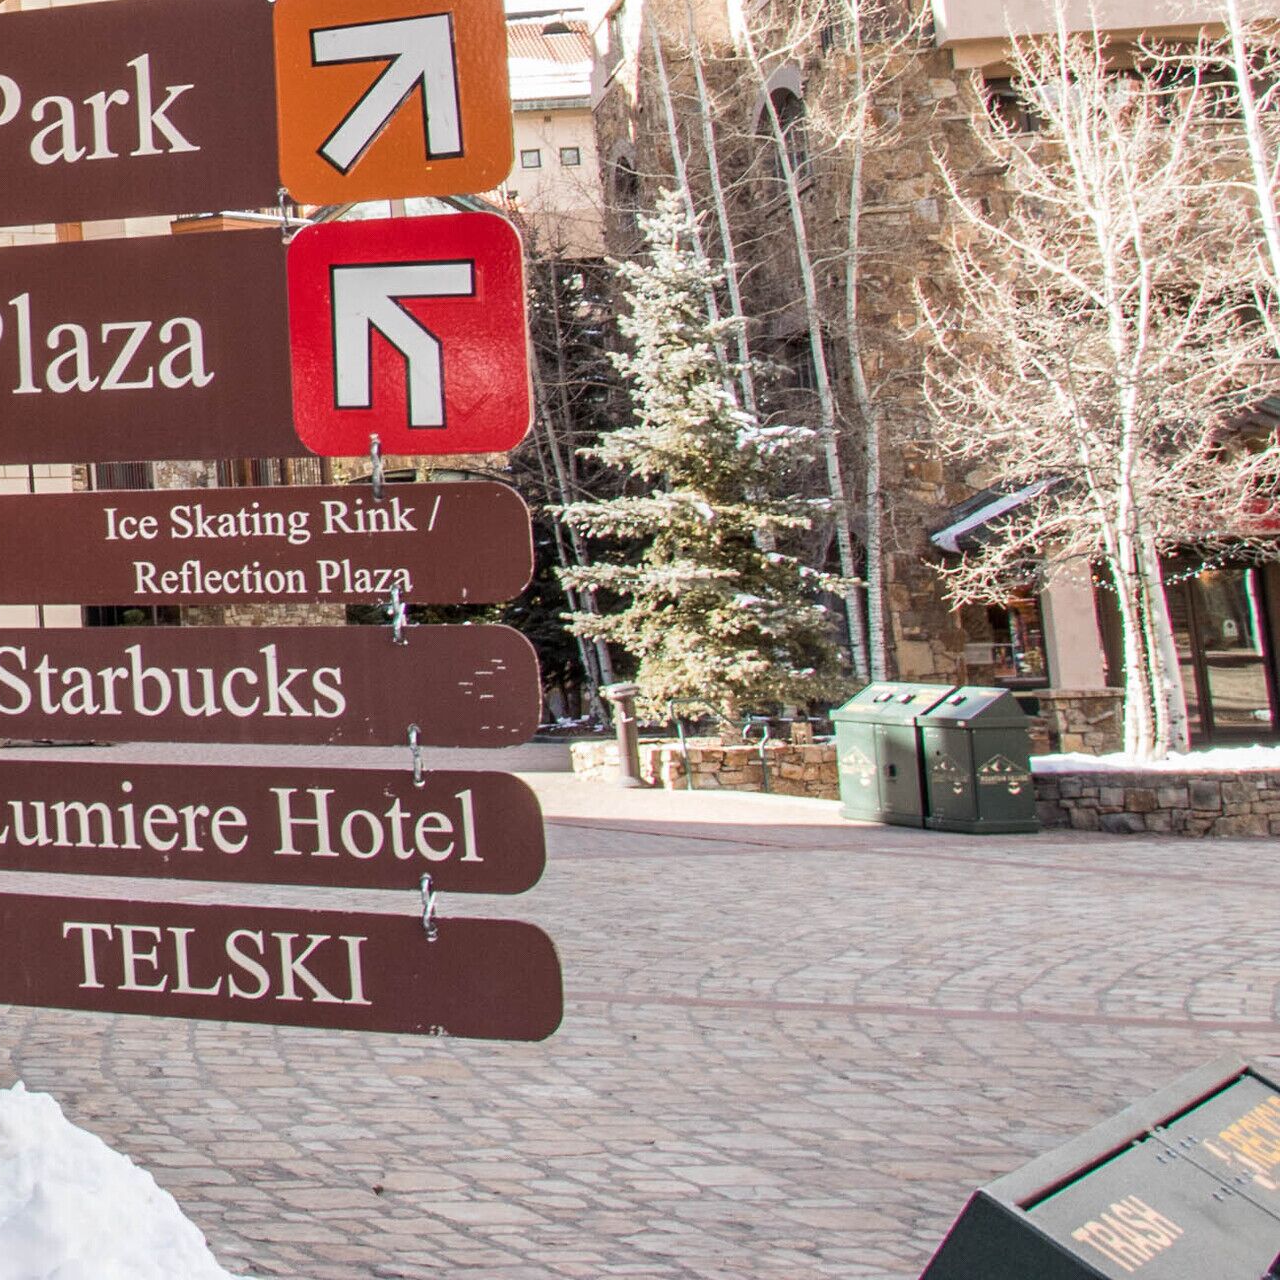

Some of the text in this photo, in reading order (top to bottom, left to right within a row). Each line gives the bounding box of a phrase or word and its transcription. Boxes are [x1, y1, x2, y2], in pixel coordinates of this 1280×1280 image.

[103, 495, 441, 545] Ice Skating Rink /
[133, 558, 414, 595] Reflection Plaza
[269, 784, 484, 863] Hotel
[62, 921, 372, 1007] TELSKI
[1070, 1194, 1184, 1272] TRASH
